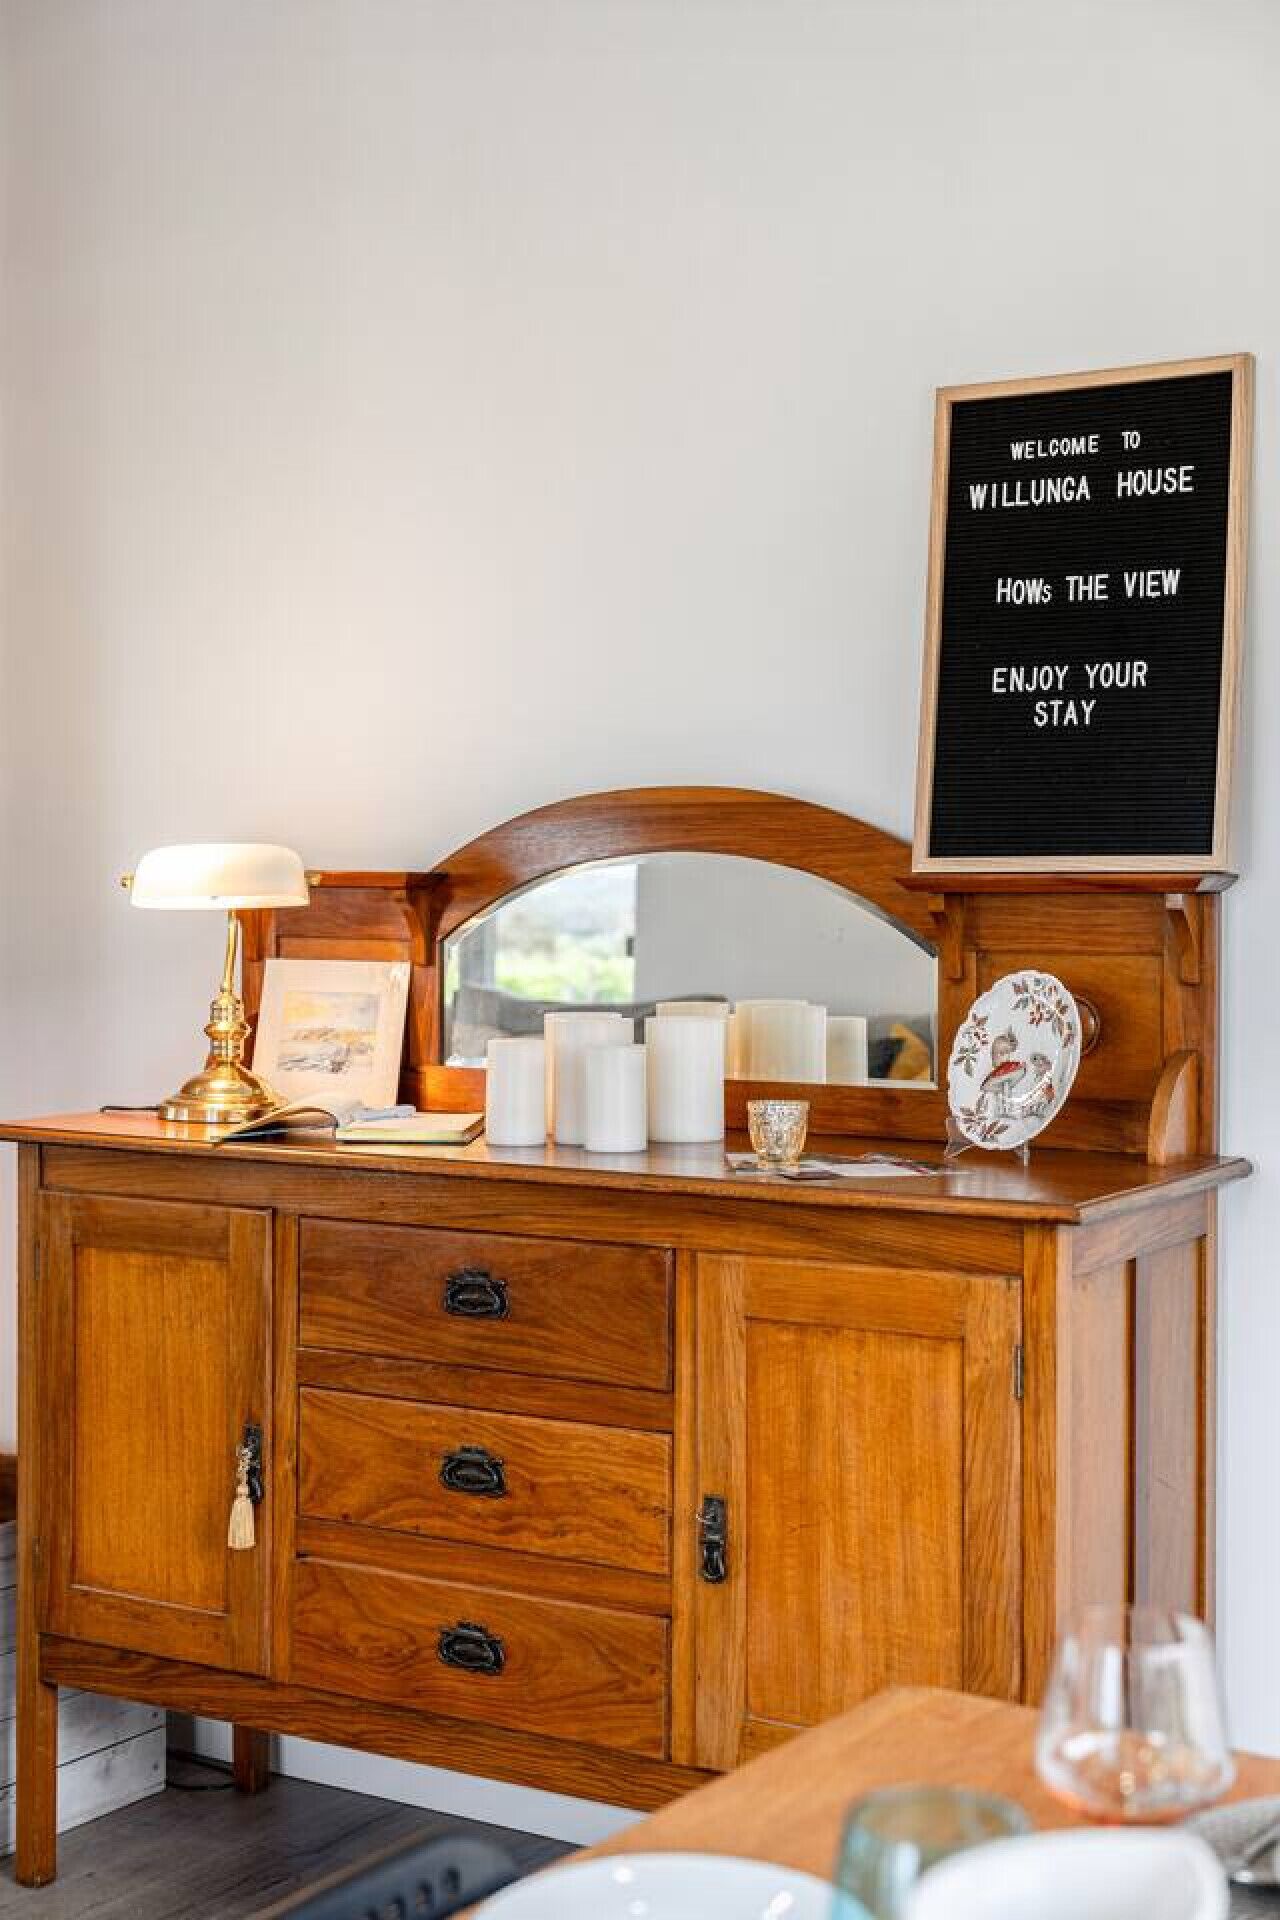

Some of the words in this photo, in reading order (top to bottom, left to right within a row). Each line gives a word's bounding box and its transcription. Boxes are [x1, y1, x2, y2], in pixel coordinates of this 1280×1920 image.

[1010, 433, 1100, 461] WELCOME
[1121, 430, 1141, 449] TO
[969, 475, 1091, 511] WILLUNGA
[1117, 465, 1195, 499] HOUSE
[1066, 573, 1109, 602] THE
[1123, 569, 1181, 599] VIEW
[991, 665, 1069, 693] ENJOY
[1085, 660, 1149, 689] YOUR
[1033, 699, 1097, 727] STAY
